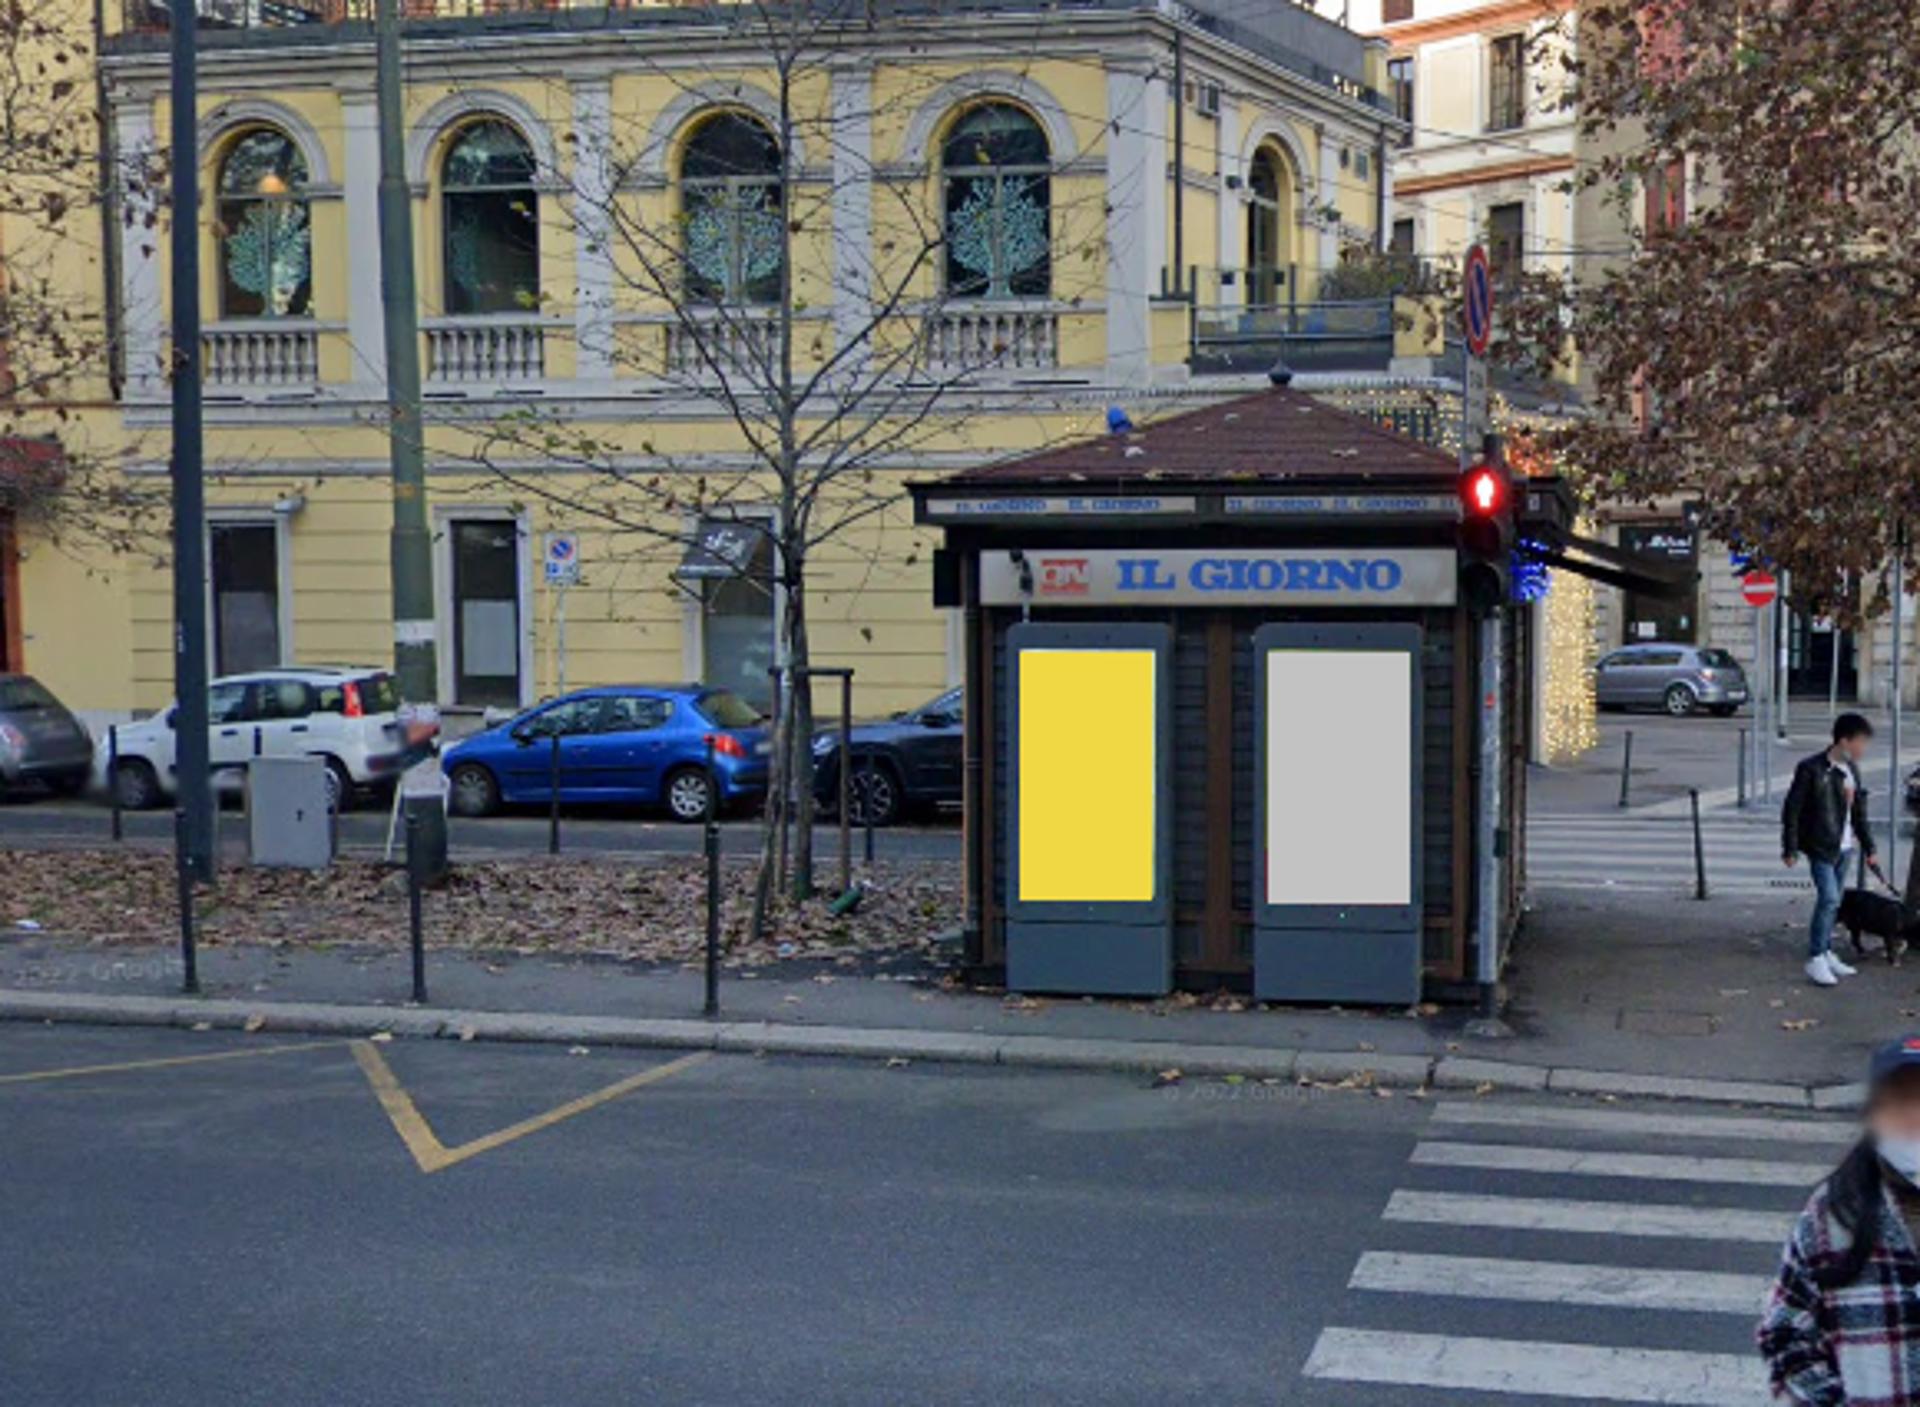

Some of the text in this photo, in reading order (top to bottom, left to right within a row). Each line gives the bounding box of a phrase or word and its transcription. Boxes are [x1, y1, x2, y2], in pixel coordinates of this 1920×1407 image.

[1067, 499, 1087, 511] IL
[1091, 499, 1160, 511] GIORNO
[1117, 558, 1402, 592] IL GIORNO
